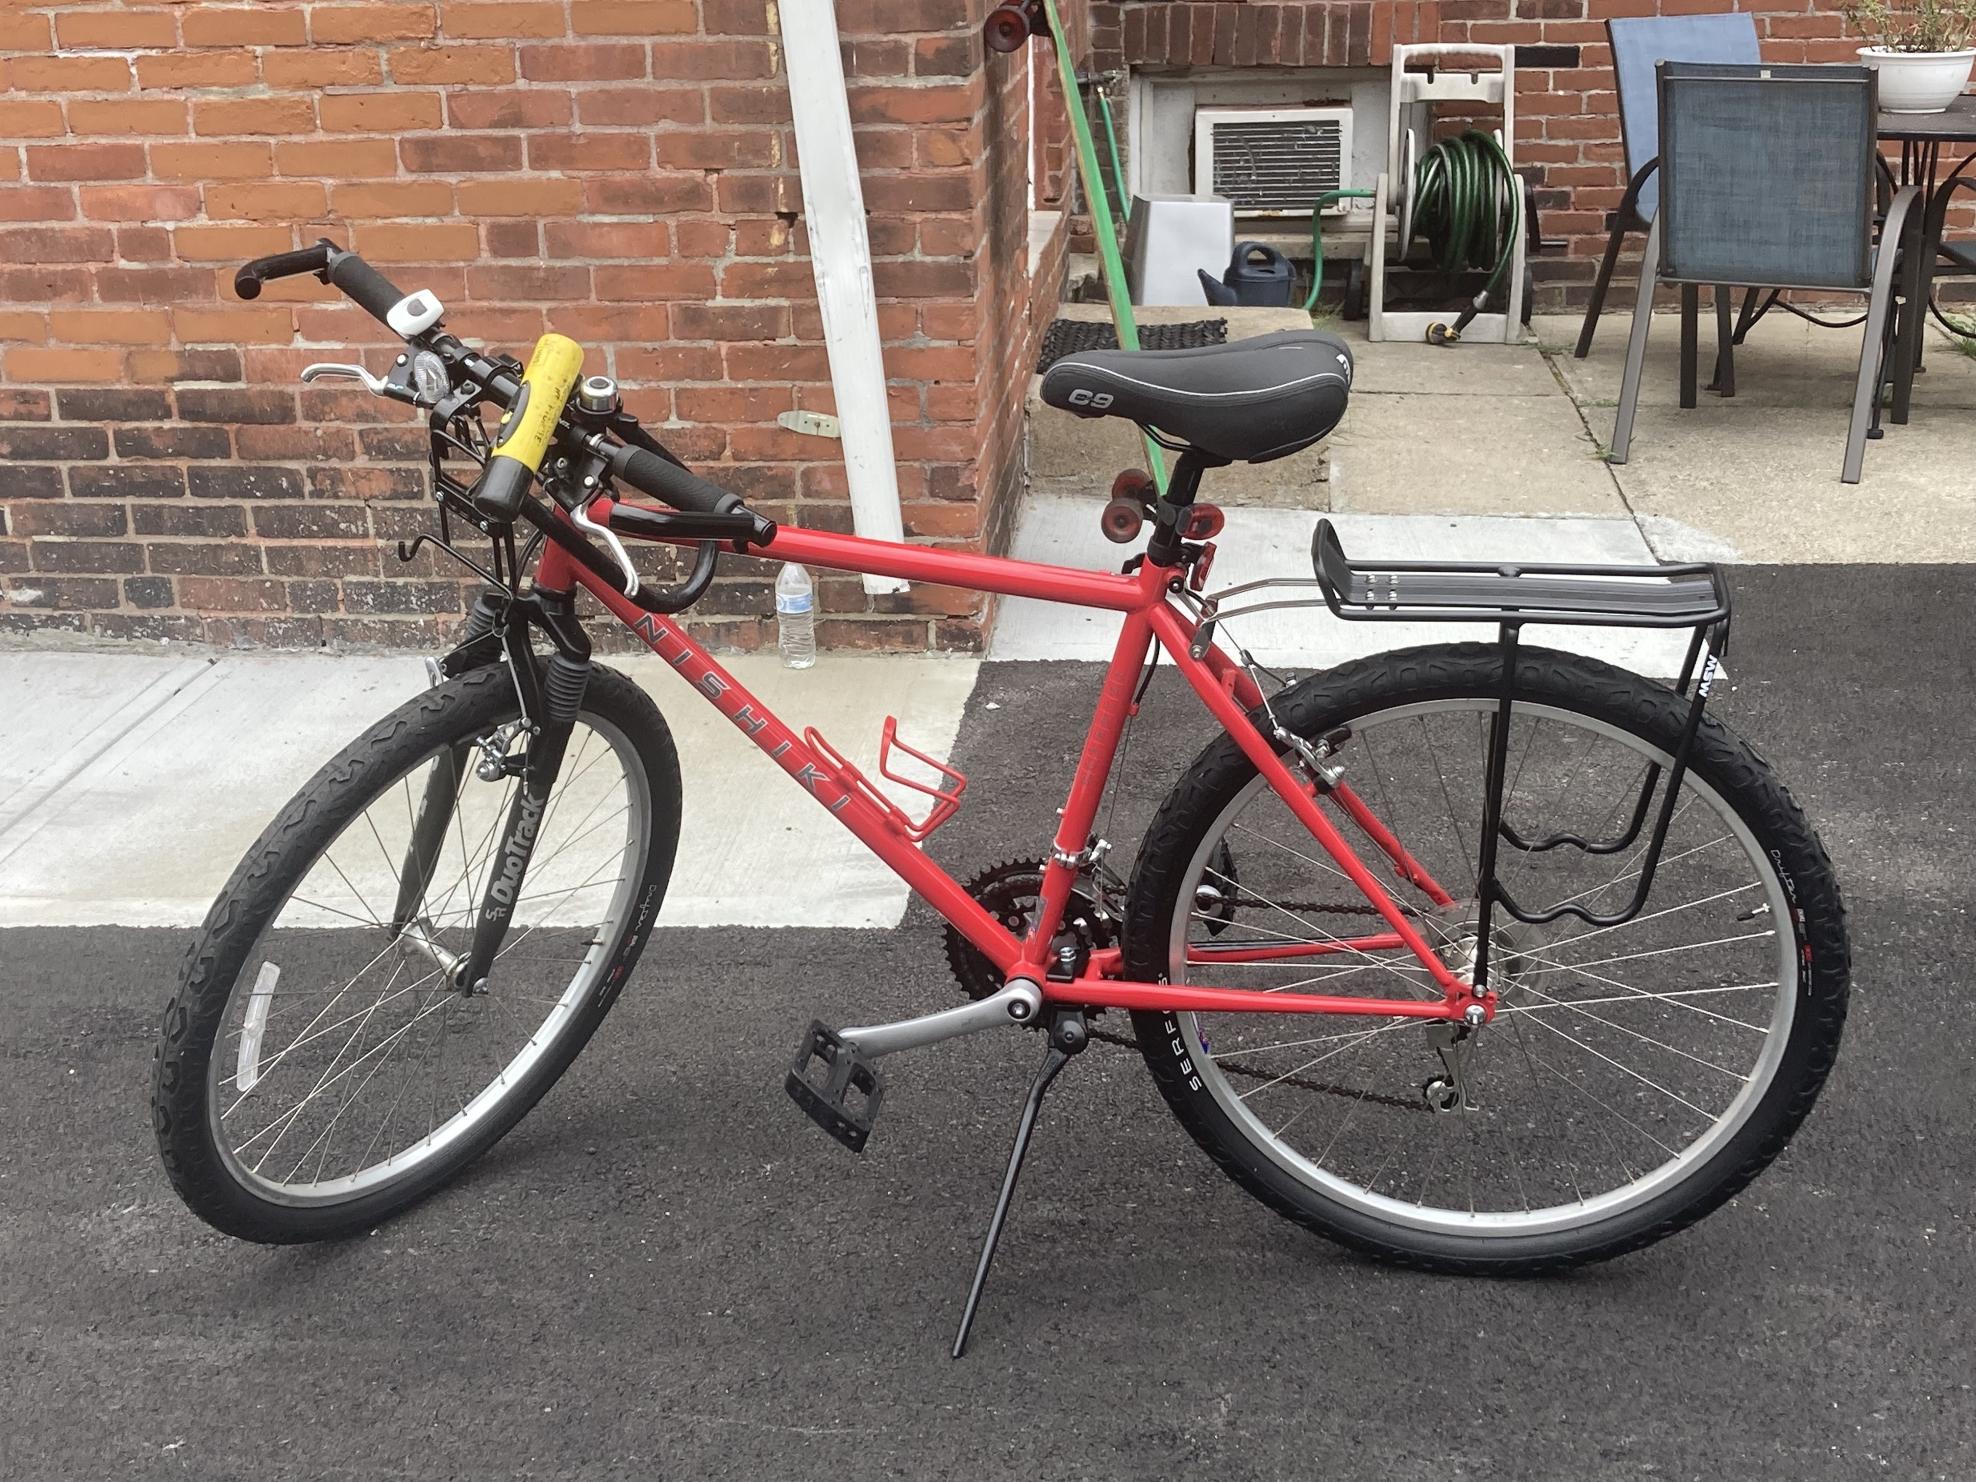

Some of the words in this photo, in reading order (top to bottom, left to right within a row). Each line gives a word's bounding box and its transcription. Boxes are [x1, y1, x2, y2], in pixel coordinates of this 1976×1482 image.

[1068, 388, 1114, 409] C9
[1698, 654, 1718, 698] MSW
[635, 612, 850, 812] NISHIKI
[490, 792, 545, 905] DuoTrack
[1770, 849, 1797, 904] Drifter
[634, 884, 657, 932] Drifter
[1158, 976, 1203, 1091] SERFS
